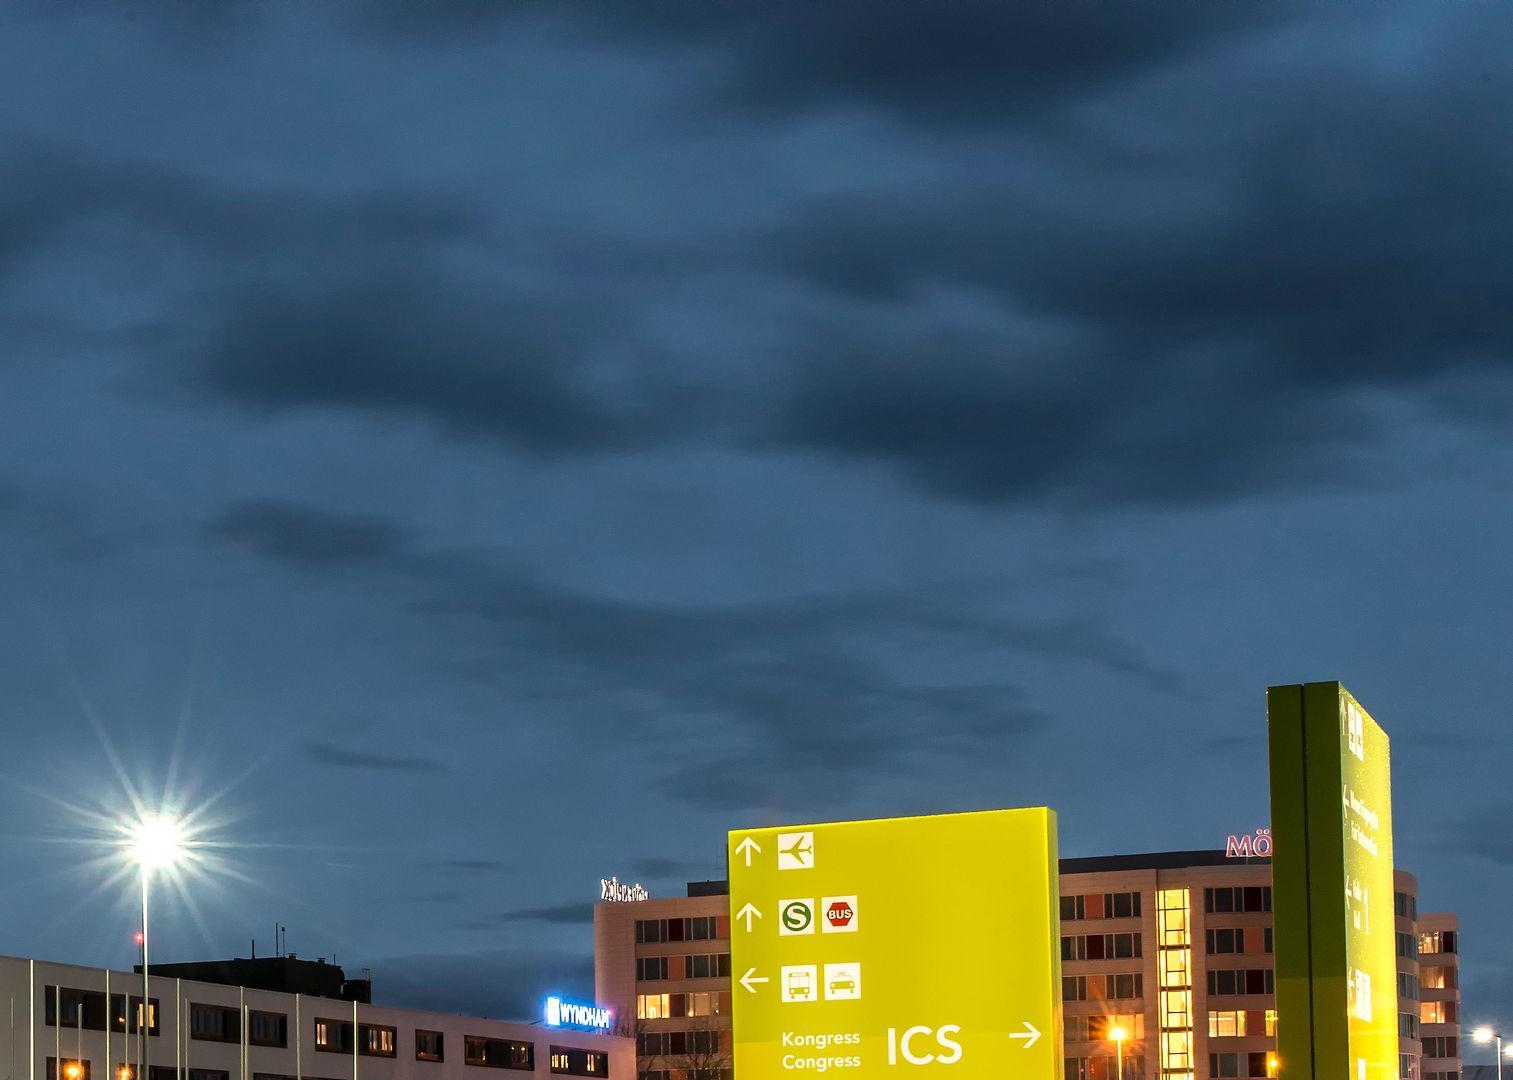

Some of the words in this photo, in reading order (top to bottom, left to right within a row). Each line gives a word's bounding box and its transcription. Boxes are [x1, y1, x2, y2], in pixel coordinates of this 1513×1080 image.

[828, 909, 852, 919] BUS
[560, 1003, 609, 1028] WYNDHAM
[782, 1031, 861, 1050] Kongress
[887, 1024, 963, 1066] ICS
[782, 1054, 861, 1073] Congress
